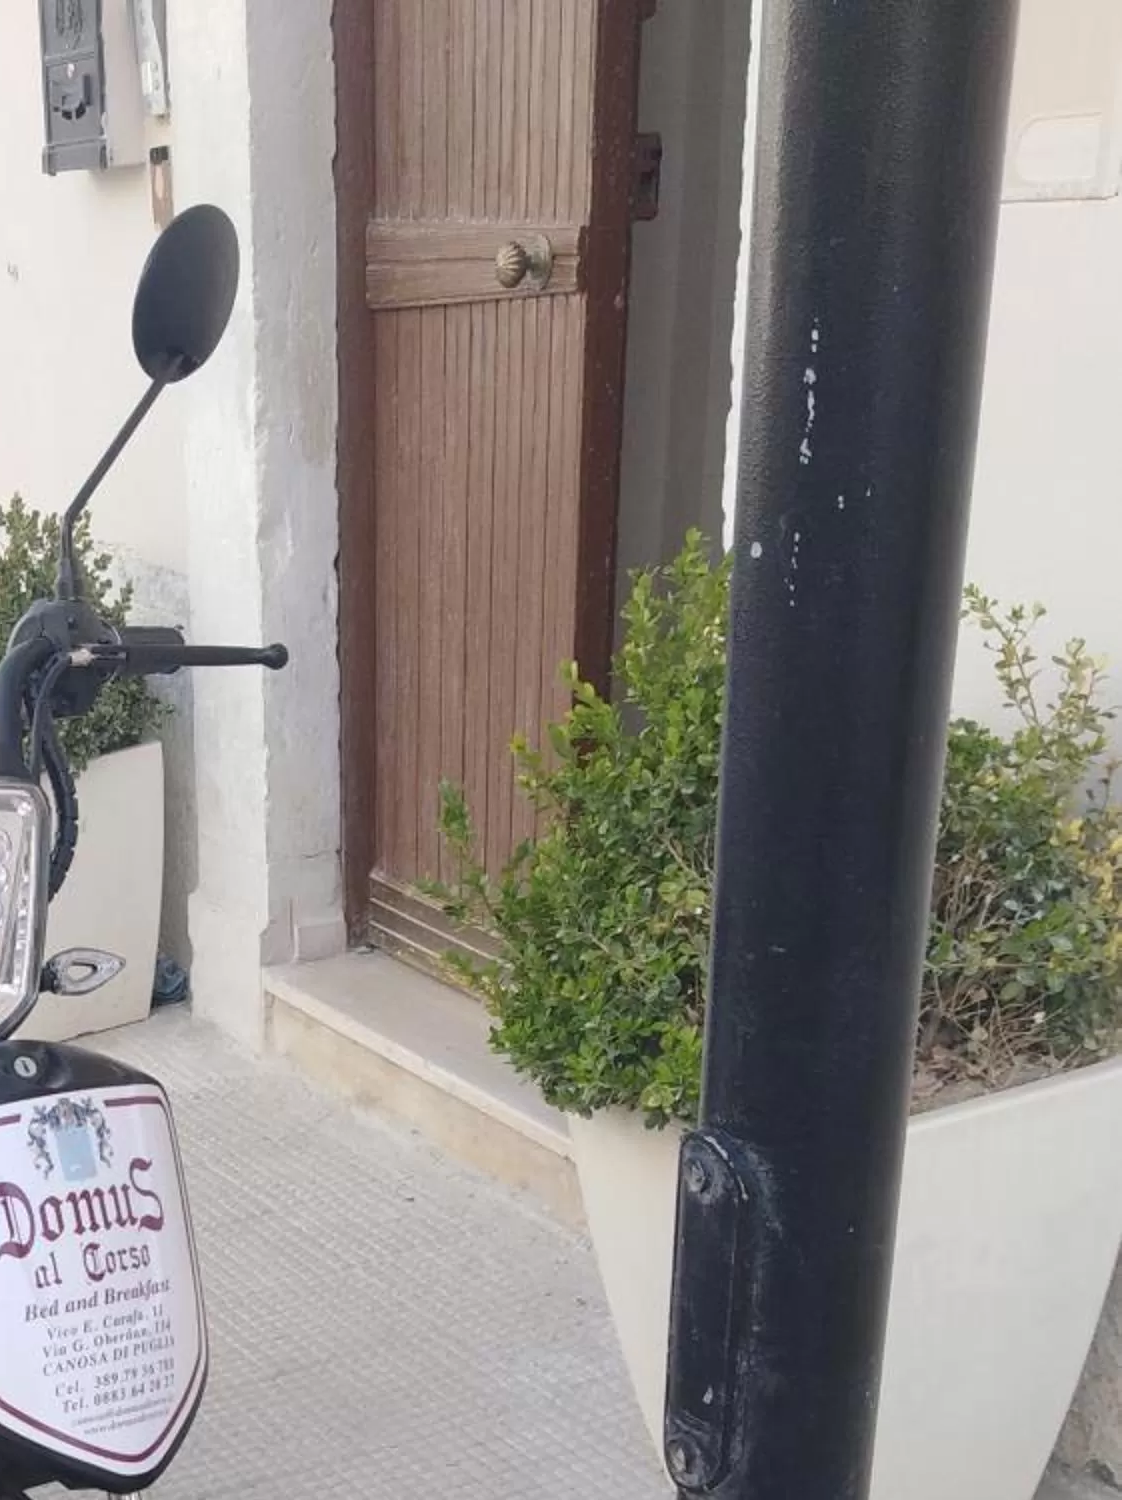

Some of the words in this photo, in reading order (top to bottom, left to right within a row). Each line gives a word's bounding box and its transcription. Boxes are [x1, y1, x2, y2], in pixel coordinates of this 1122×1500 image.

[34, 1251, 63, 1289] al
[83, 1242, 151, 1281] Corso
[25, 1299, 59, 1322] Bed
[64, 1290, 98, 1314] and
[104, 1278, 171, 1305] Breakfast
[42, 1344, 67, 1359] Via
[72, 1339, 90, 1353] G.
[42, 1350, 108, 1377] CANOSA
[113, 1345, 129, 1361] DI
[133, 1334, 175, 1357] PUGLIA
[62, 1396, 90, 1414] Tel.
